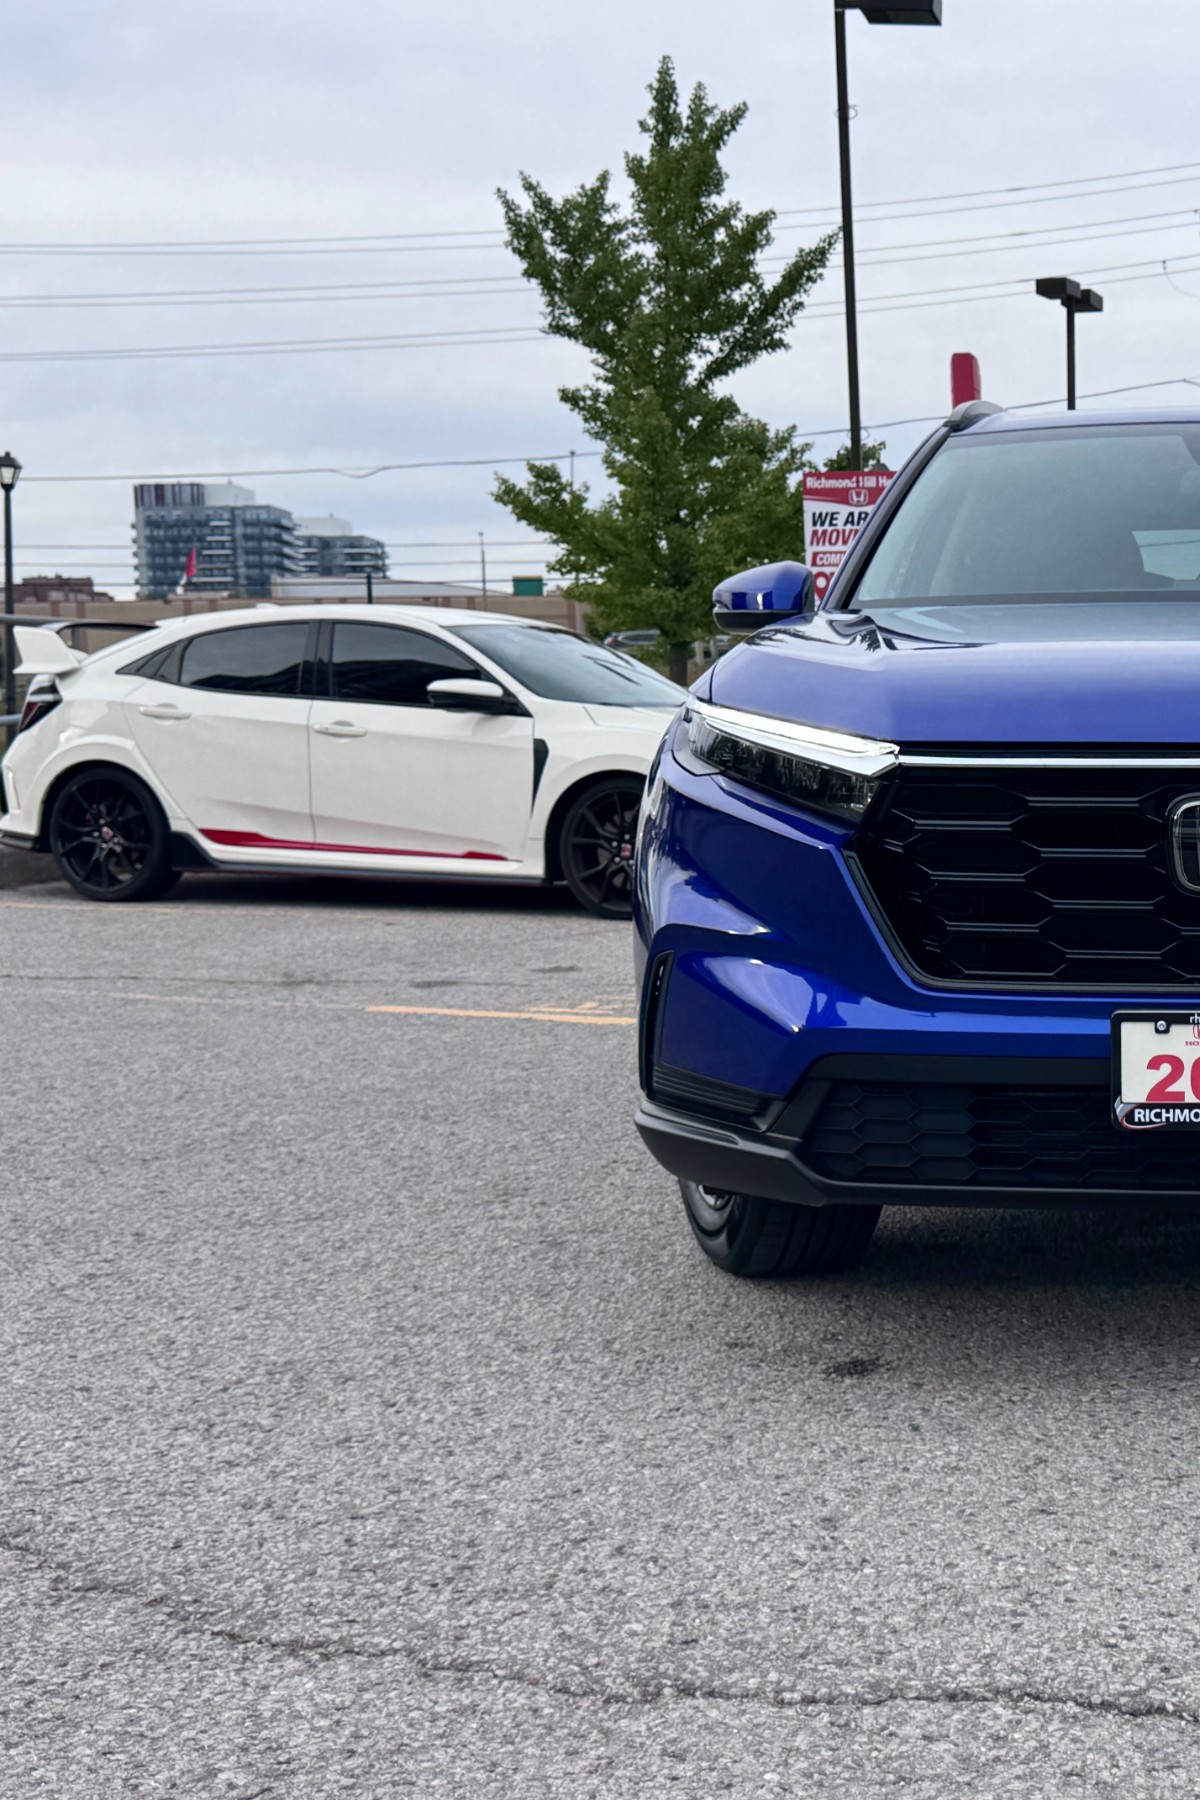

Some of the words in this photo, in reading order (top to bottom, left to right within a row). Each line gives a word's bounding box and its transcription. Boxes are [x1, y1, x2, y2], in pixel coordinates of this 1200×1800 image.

[806, 476, 857, 488] Richmond
[859, 476, 877, 488] Hill
[811, 511, 840, 527] WE
[843, 511, 869, 527] AR
[809, 529, 859, 546] MOVI
